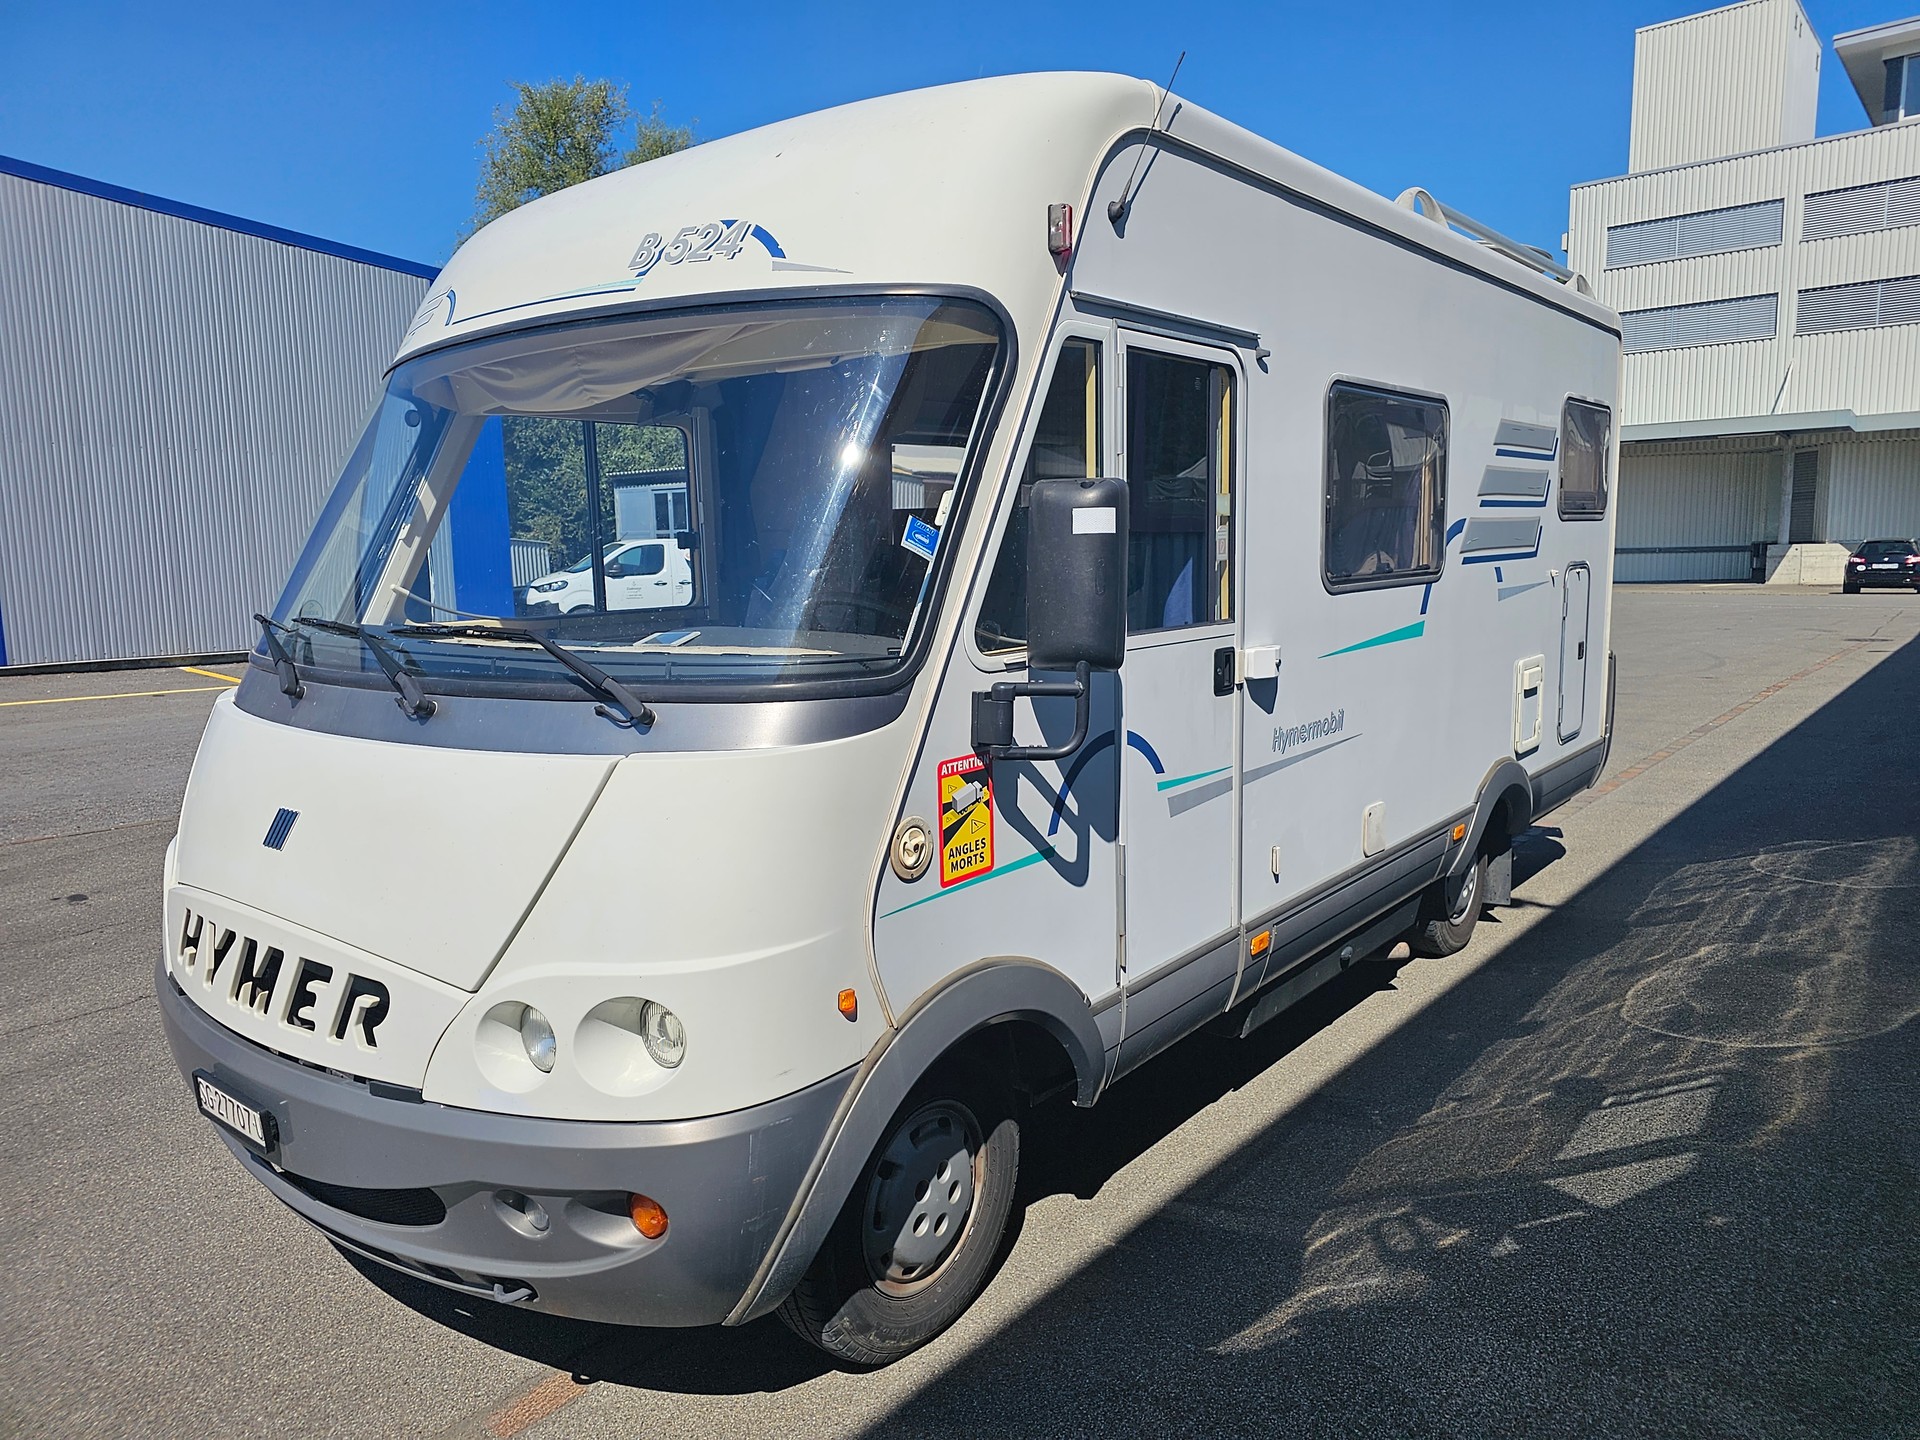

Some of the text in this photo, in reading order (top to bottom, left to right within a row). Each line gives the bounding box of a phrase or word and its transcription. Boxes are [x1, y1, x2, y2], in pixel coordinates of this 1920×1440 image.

[628, 220, 752, 271] B 524
[1272, 708, 1345, 755] Hymermobil
[948, 837, 987, 861] ANGLES
[950, 851, 986, 874] MORTS
[177, 907, 391, 1053] HYMER
